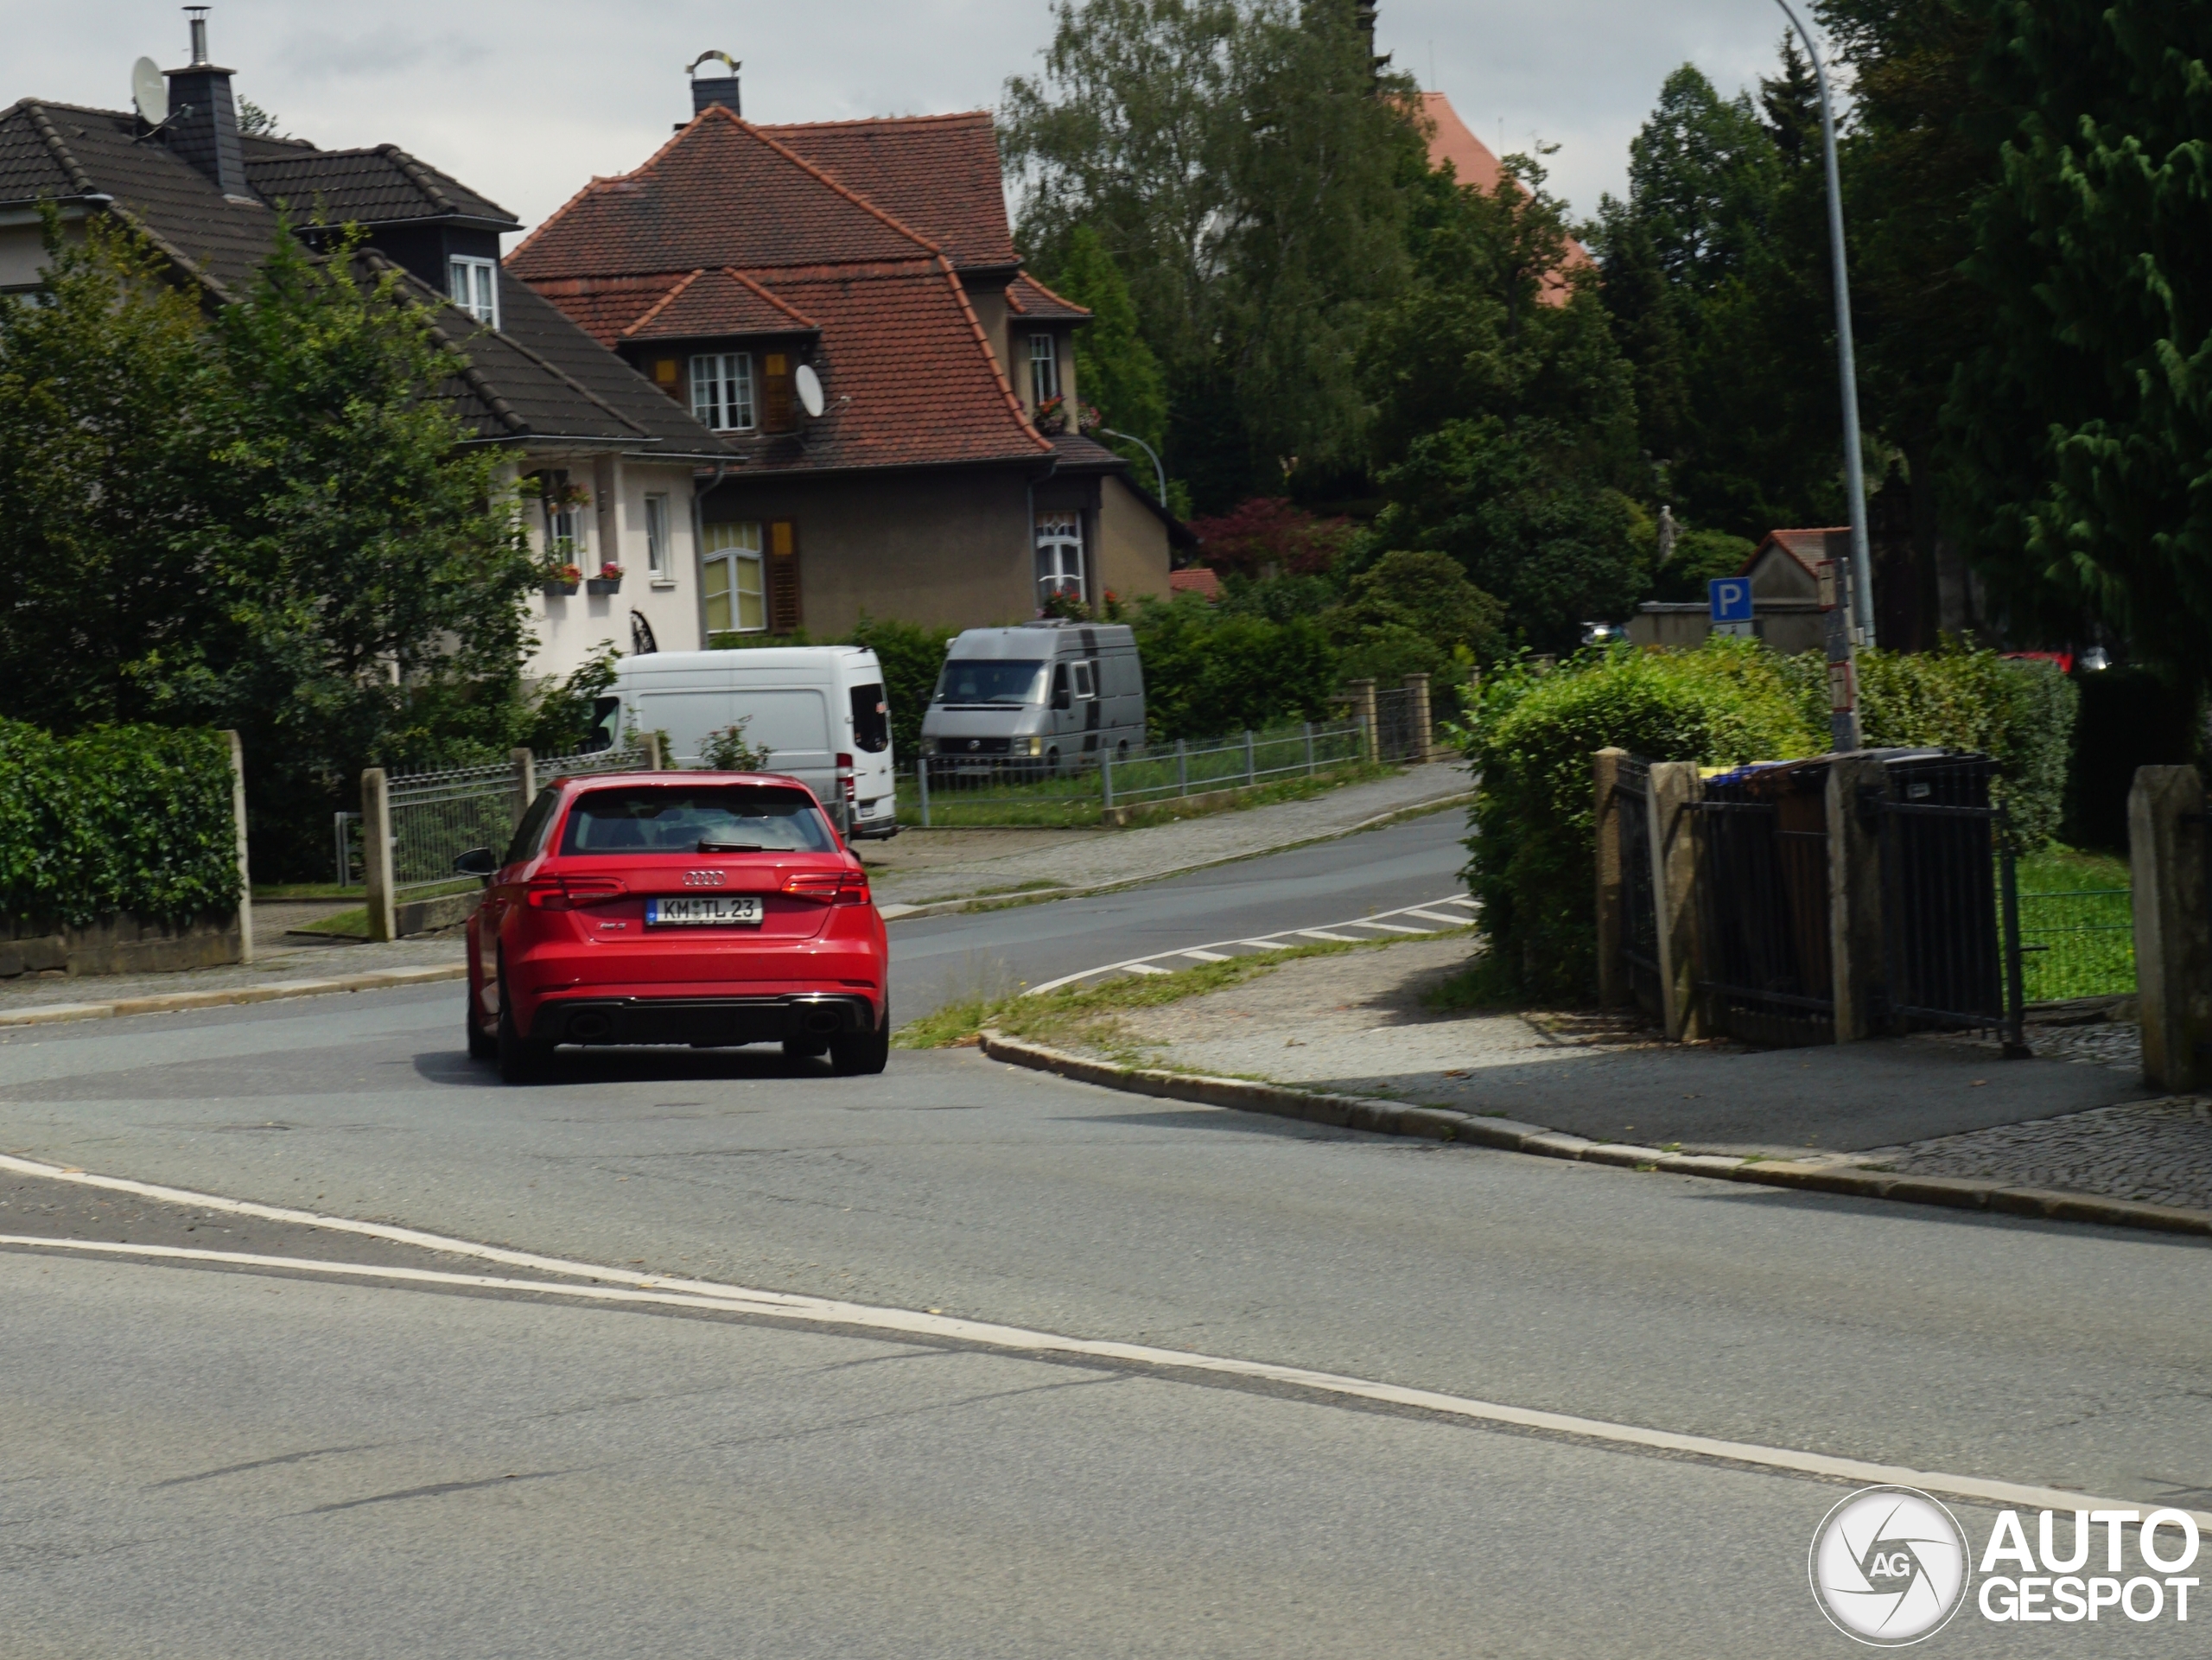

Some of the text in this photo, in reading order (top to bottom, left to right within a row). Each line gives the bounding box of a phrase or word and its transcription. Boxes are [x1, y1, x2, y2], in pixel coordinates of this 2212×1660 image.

[1719, 584, 1742, 615] P
[664, 900, 754, 919] KM TL 23
